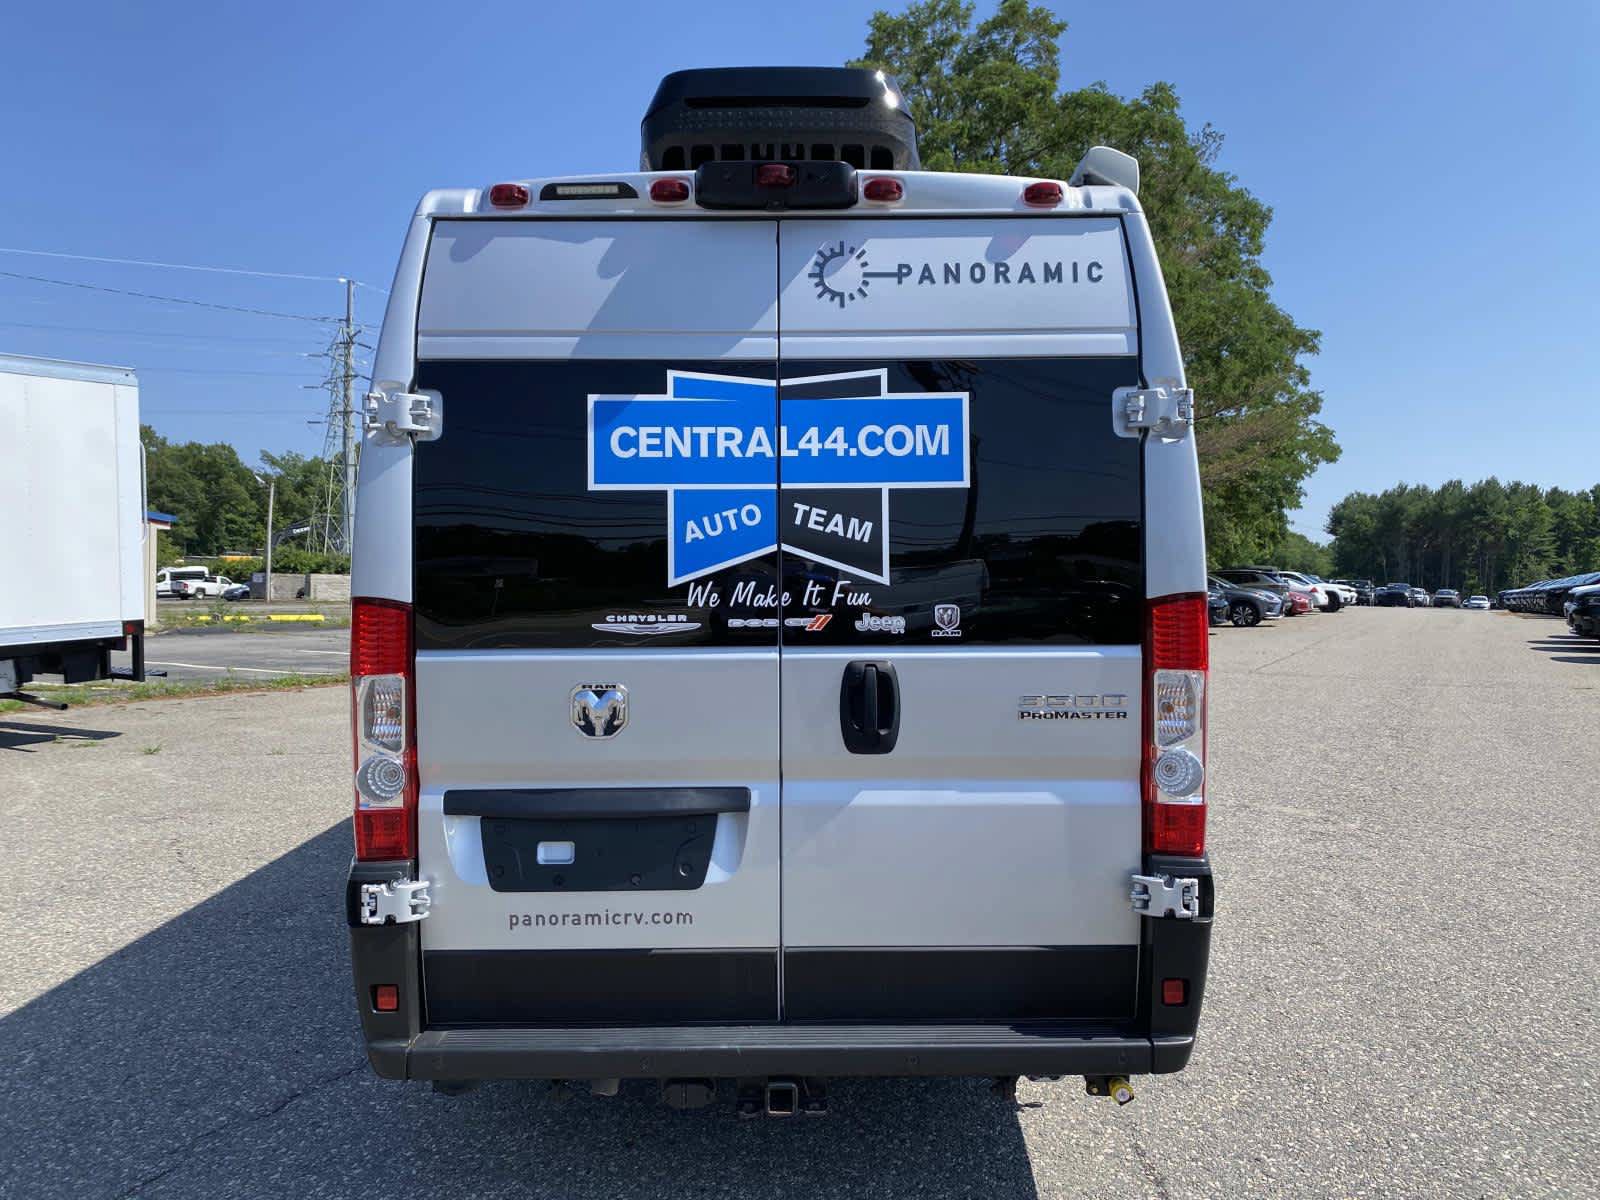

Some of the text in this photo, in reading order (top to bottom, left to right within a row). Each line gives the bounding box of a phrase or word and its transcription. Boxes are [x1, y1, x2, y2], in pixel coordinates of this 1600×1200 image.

[897, 261, 1105, 286] PANORAMIC
[609, 424, 951, 458] CENTRAL44.COM
[684, 502, 873, 544] AUTO TEAM
[687, 579, 872, 608] We Make It Fun
[605, 614, 688, 622] CHRYSLER
[855, 612, 906, 633] Jeep
[931, 629, 961, 637] RAM
[1019, 694, 1128, 708] 3500
[508, 908, 694, 930] panoramicrv.com
